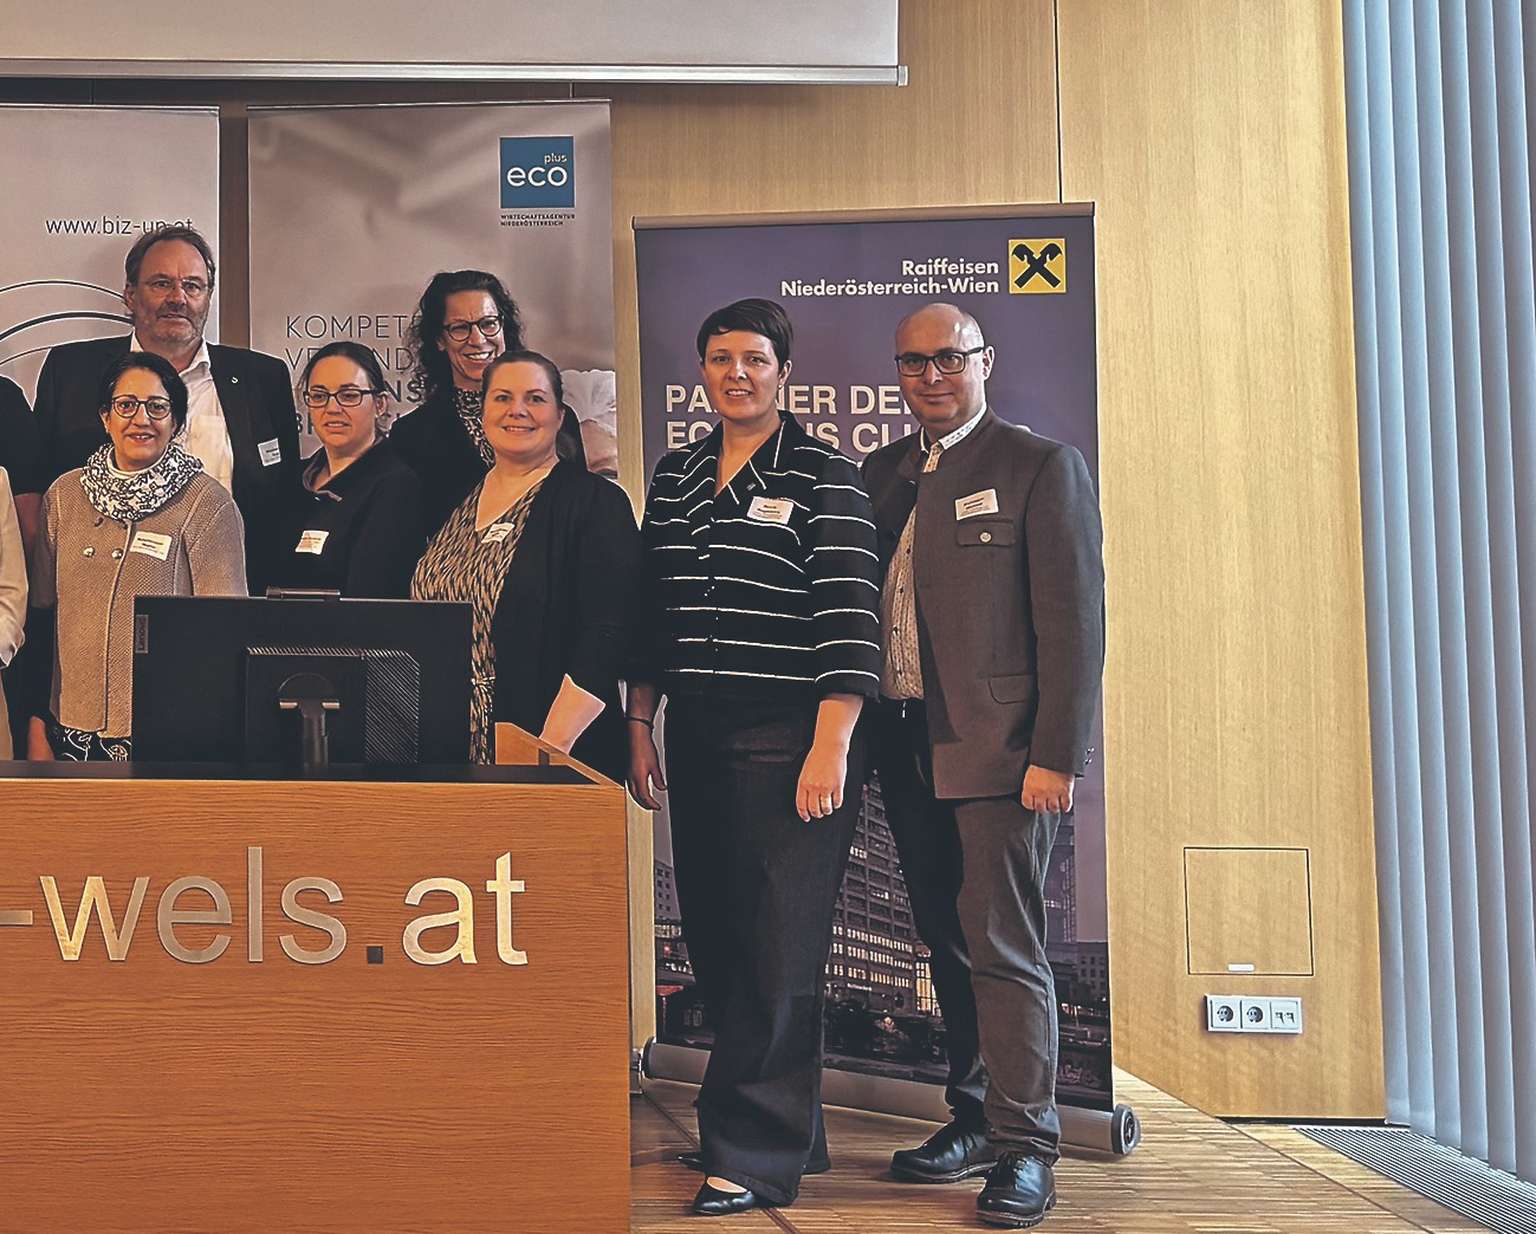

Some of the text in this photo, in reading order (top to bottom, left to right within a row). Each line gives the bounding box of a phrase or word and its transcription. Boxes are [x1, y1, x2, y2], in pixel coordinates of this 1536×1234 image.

[544, 153, 567, 164] plus
[507, 166, 568, 187] eco
[902, 258, 999, 276] Raiffeisen
[780, 277, 999, 297] Niederösterreich-Wien
[286, 315, 421, 339] KOMPET
[666, 385, 912, 414] PAER DE
